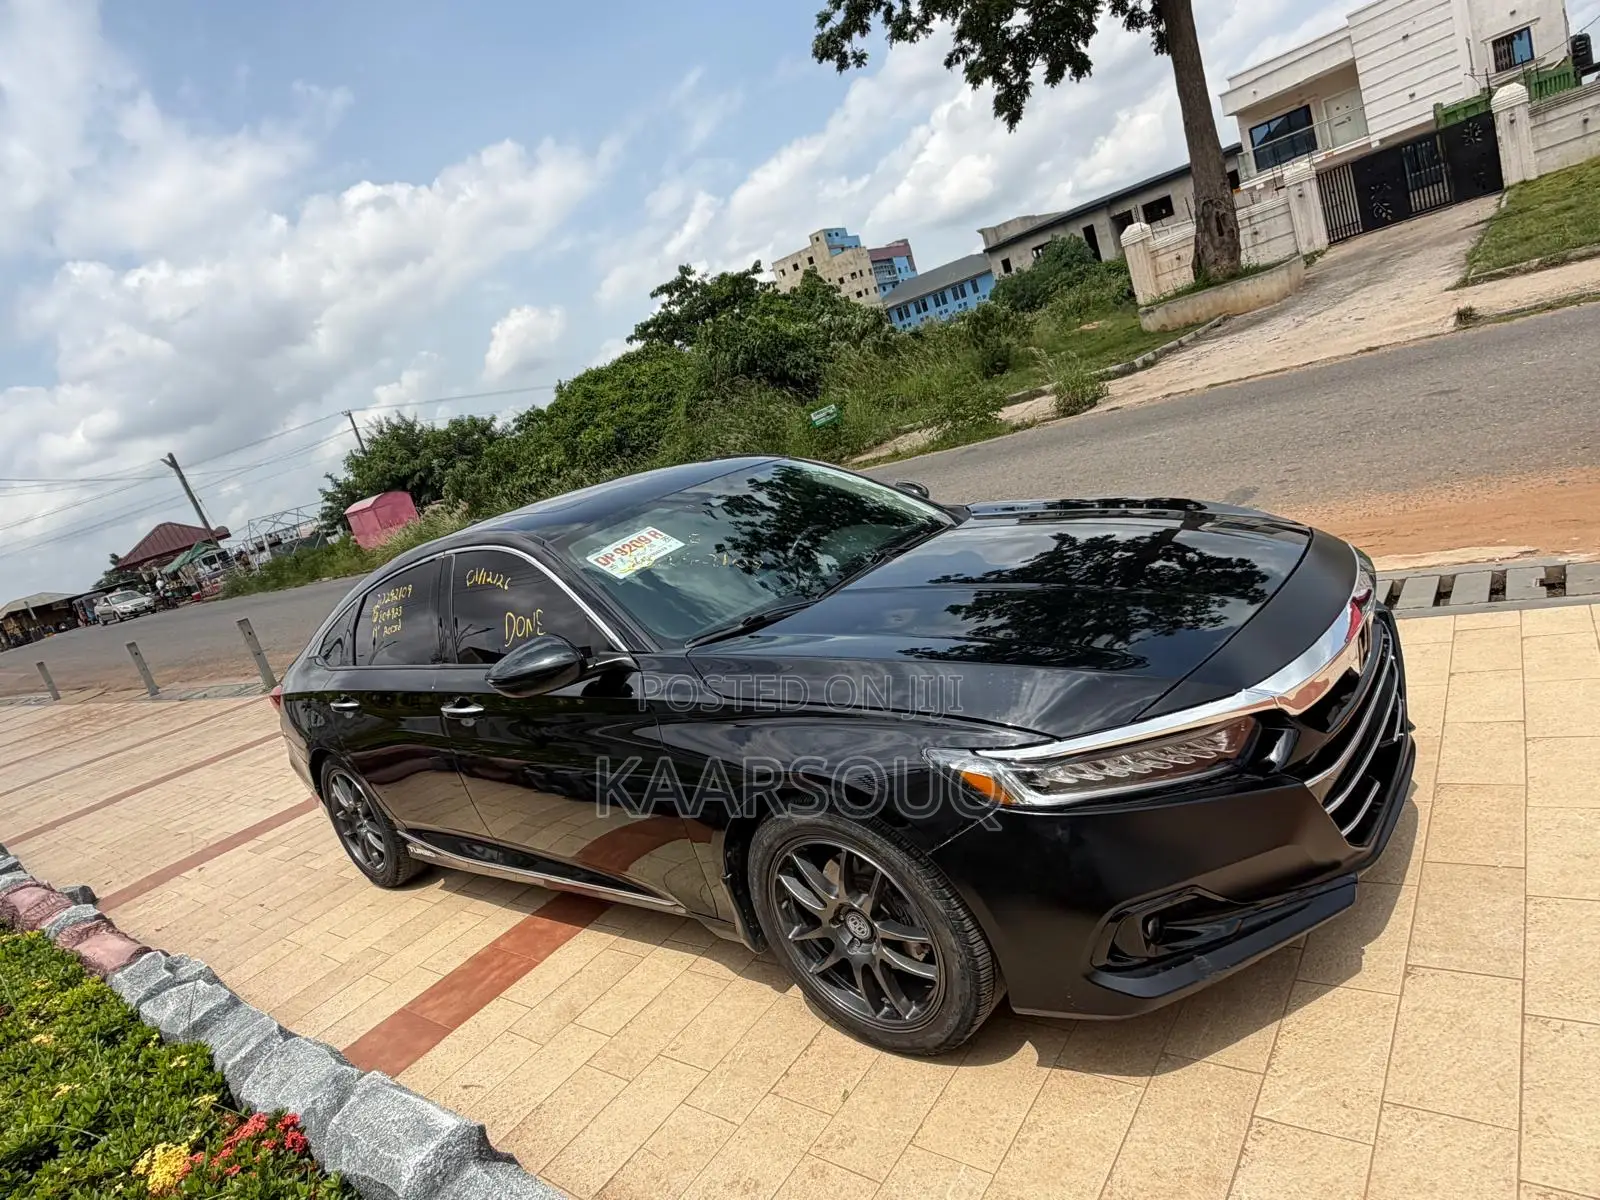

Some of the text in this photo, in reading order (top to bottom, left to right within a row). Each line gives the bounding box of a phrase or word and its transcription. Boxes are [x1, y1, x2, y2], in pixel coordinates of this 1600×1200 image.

[613, 535, 652, 557] 9209
[647, 530, 664, 540] R
[504, 608, 546, 647] DONE
